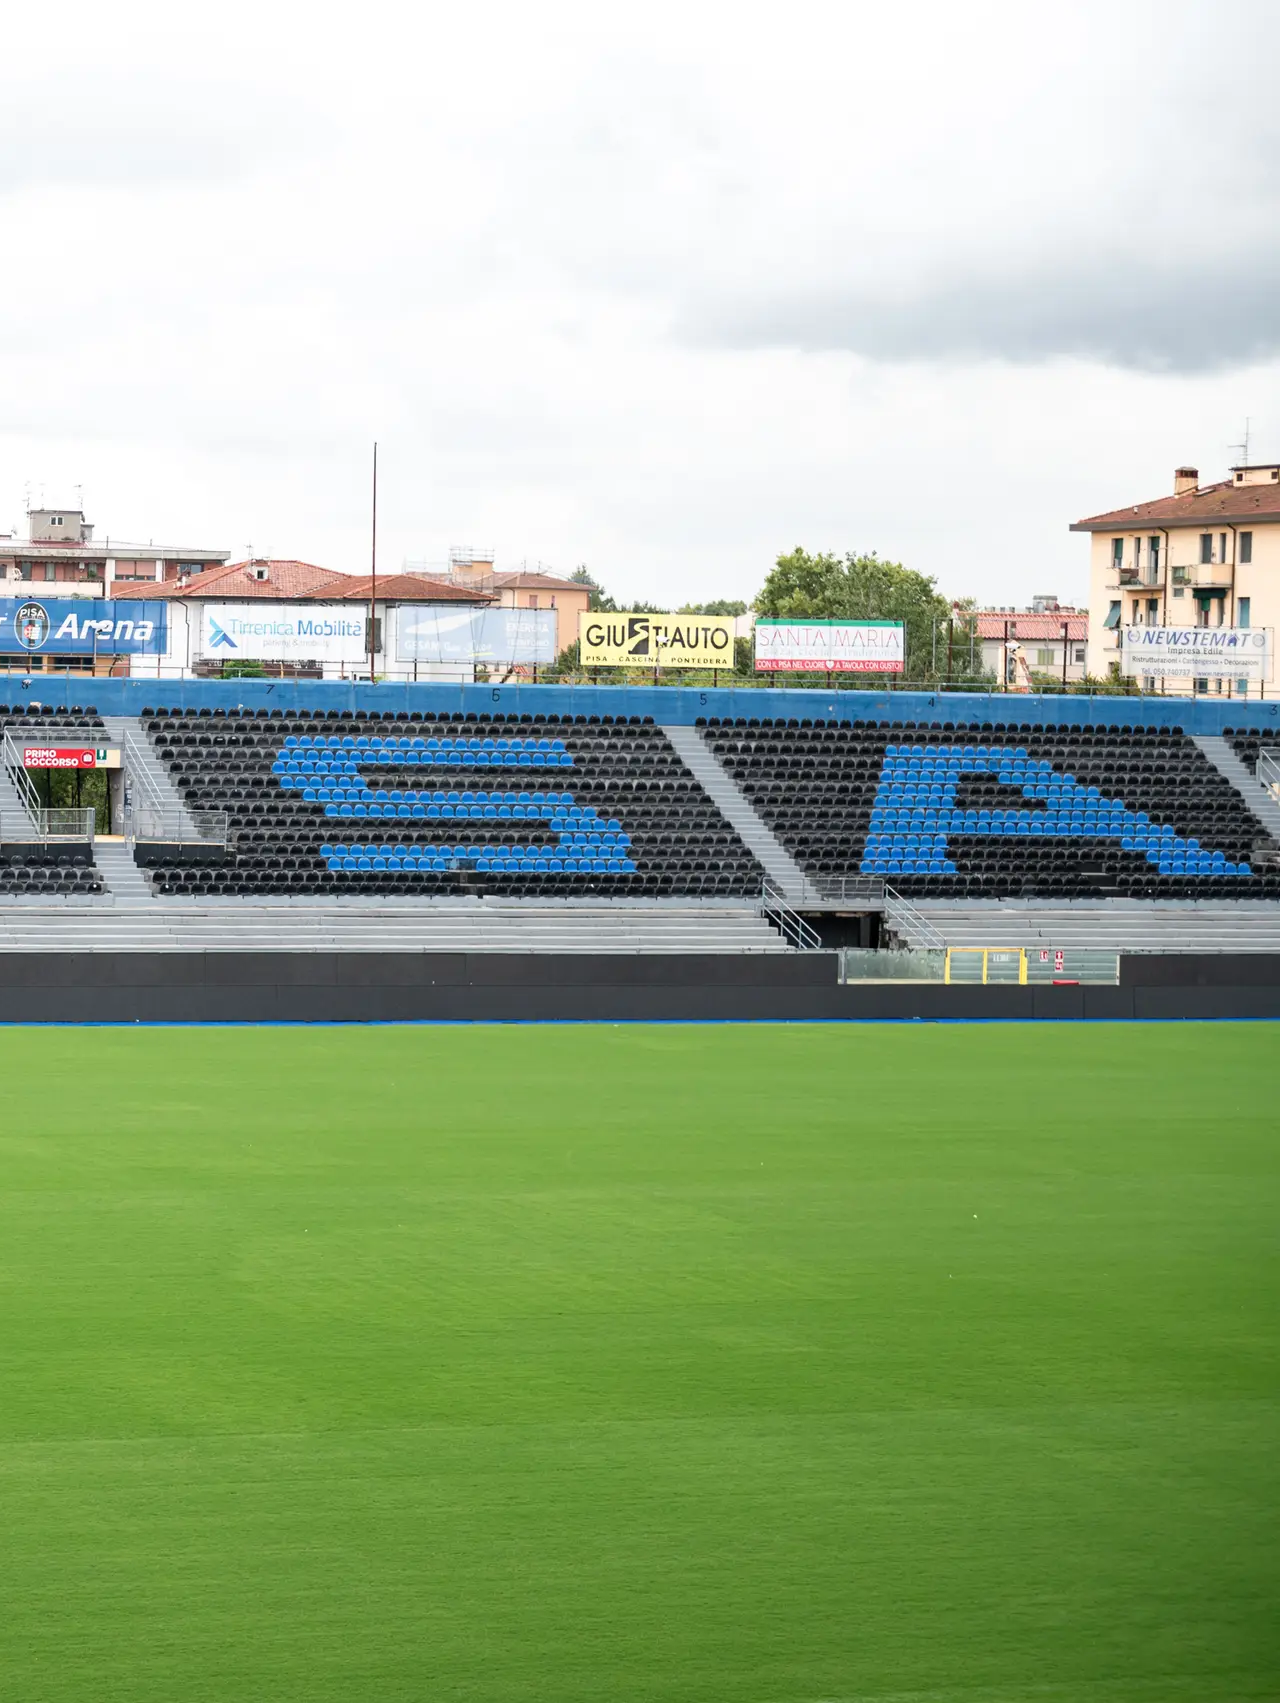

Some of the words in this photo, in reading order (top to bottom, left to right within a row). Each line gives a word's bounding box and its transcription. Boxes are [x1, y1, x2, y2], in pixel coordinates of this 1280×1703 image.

[19, 608, 45, 618] PISA
[54, 612, 154, 641] Arena
[228, 619, 294, 635] Tirrenica
[298, 620, 362, 636] Mobilità
[759, 628, 826, 646] SANTA
[834, 629, 900, 648] MARIA
[1167, 647, 1201, 656] Impresa
[1204, 648, 1223, 656] Edile
[671, 657, 728, 665] PONTEDERA
[792, 661, 804, 669] NEL
[805, 661, 825, 669] CUORE
[842, 661, 864, 669] TAVOLA
[865, 662, 879, 670] CON
[1132, 656, 1178, 664] Ristrutturazioni
[1224, 659, 1259, 667] Decorazioni
[265, 684, 275, 695] 7
[491, 688, 500, 702] 6
[699, 693, 707, 705] 5
[1269, 704, 1277, 716] 3
[25, 750, 57, 758] PRIMO
[25, 758, 79, 766] SOCCORSO
